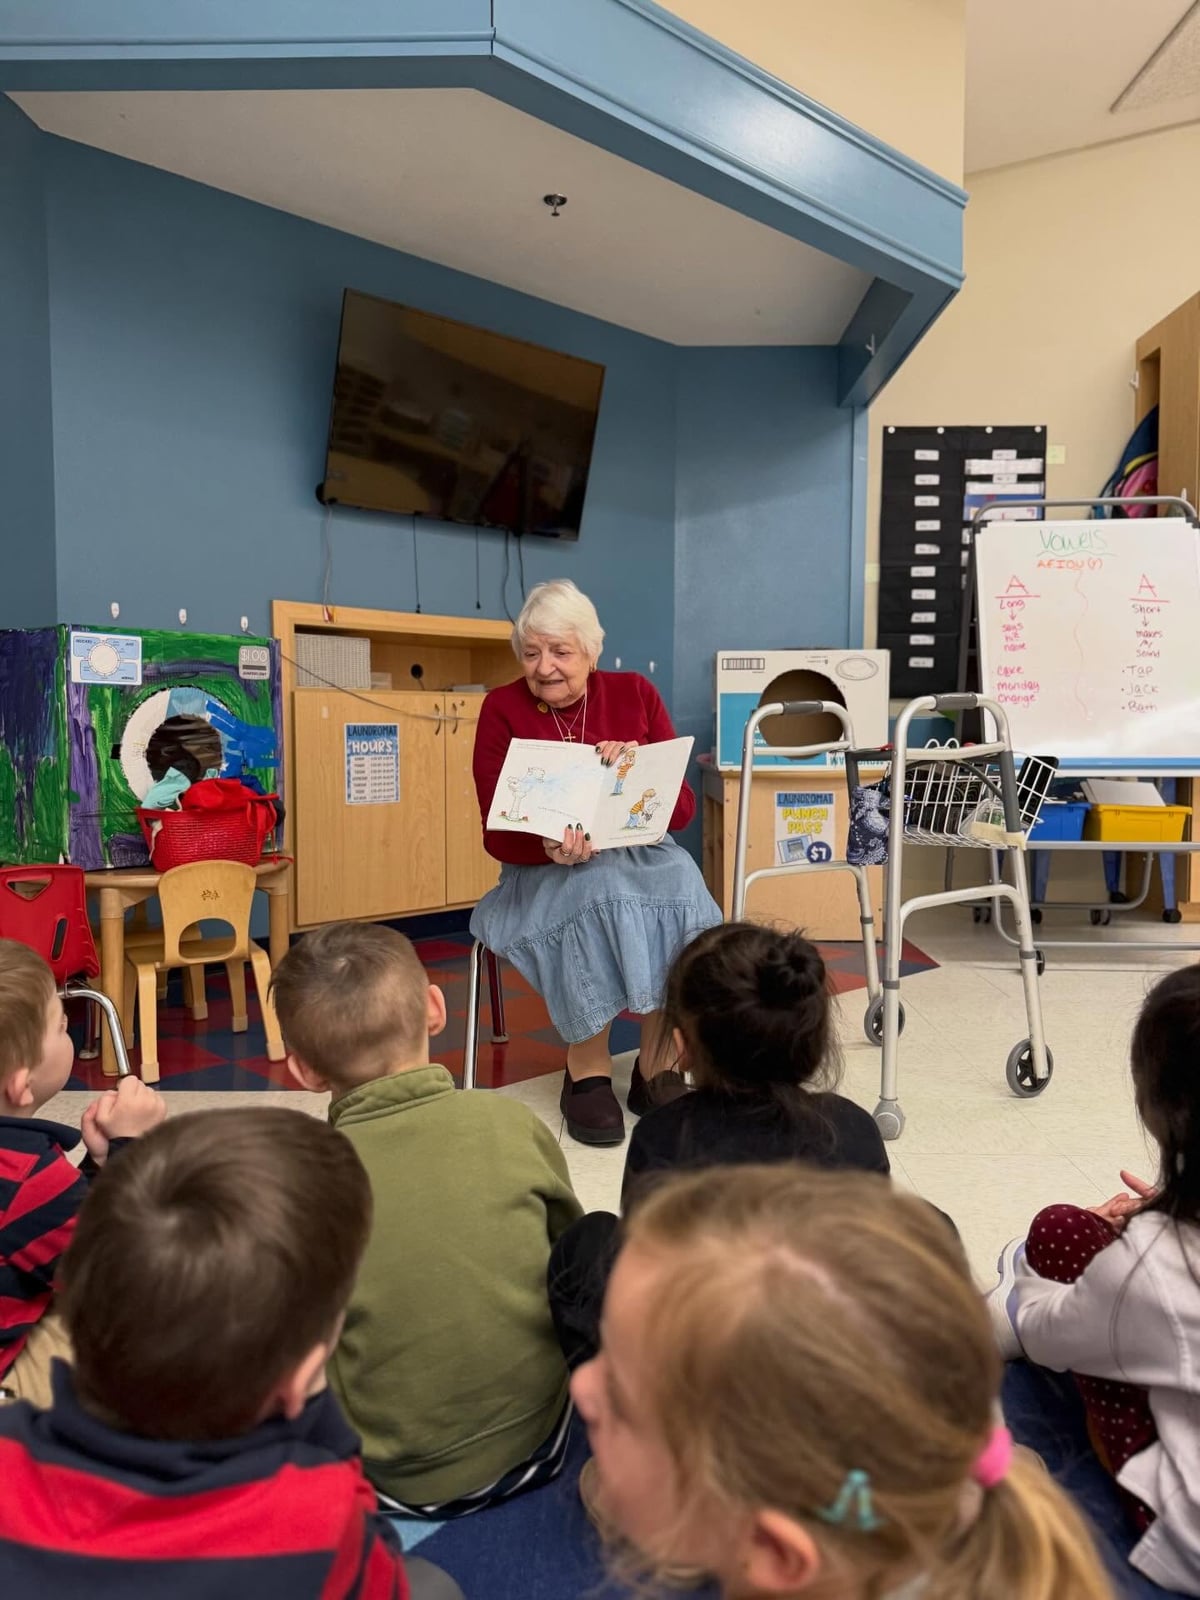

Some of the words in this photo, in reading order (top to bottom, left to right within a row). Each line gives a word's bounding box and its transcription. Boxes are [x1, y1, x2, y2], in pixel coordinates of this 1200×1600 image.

[1006, 575, 1029, 594] A
[1138, 573, 1158, 597] A
[348, 725, 397, 737] LAUNDROMAT
[352, 740, 393, 753] HOURS
[778, 793, 834, 805] LAUNDROMAT
[782, 808, 828, 820] PUNCH
[787, 821, 823, 834] PASS
[810, 846, 827, 861] $7
